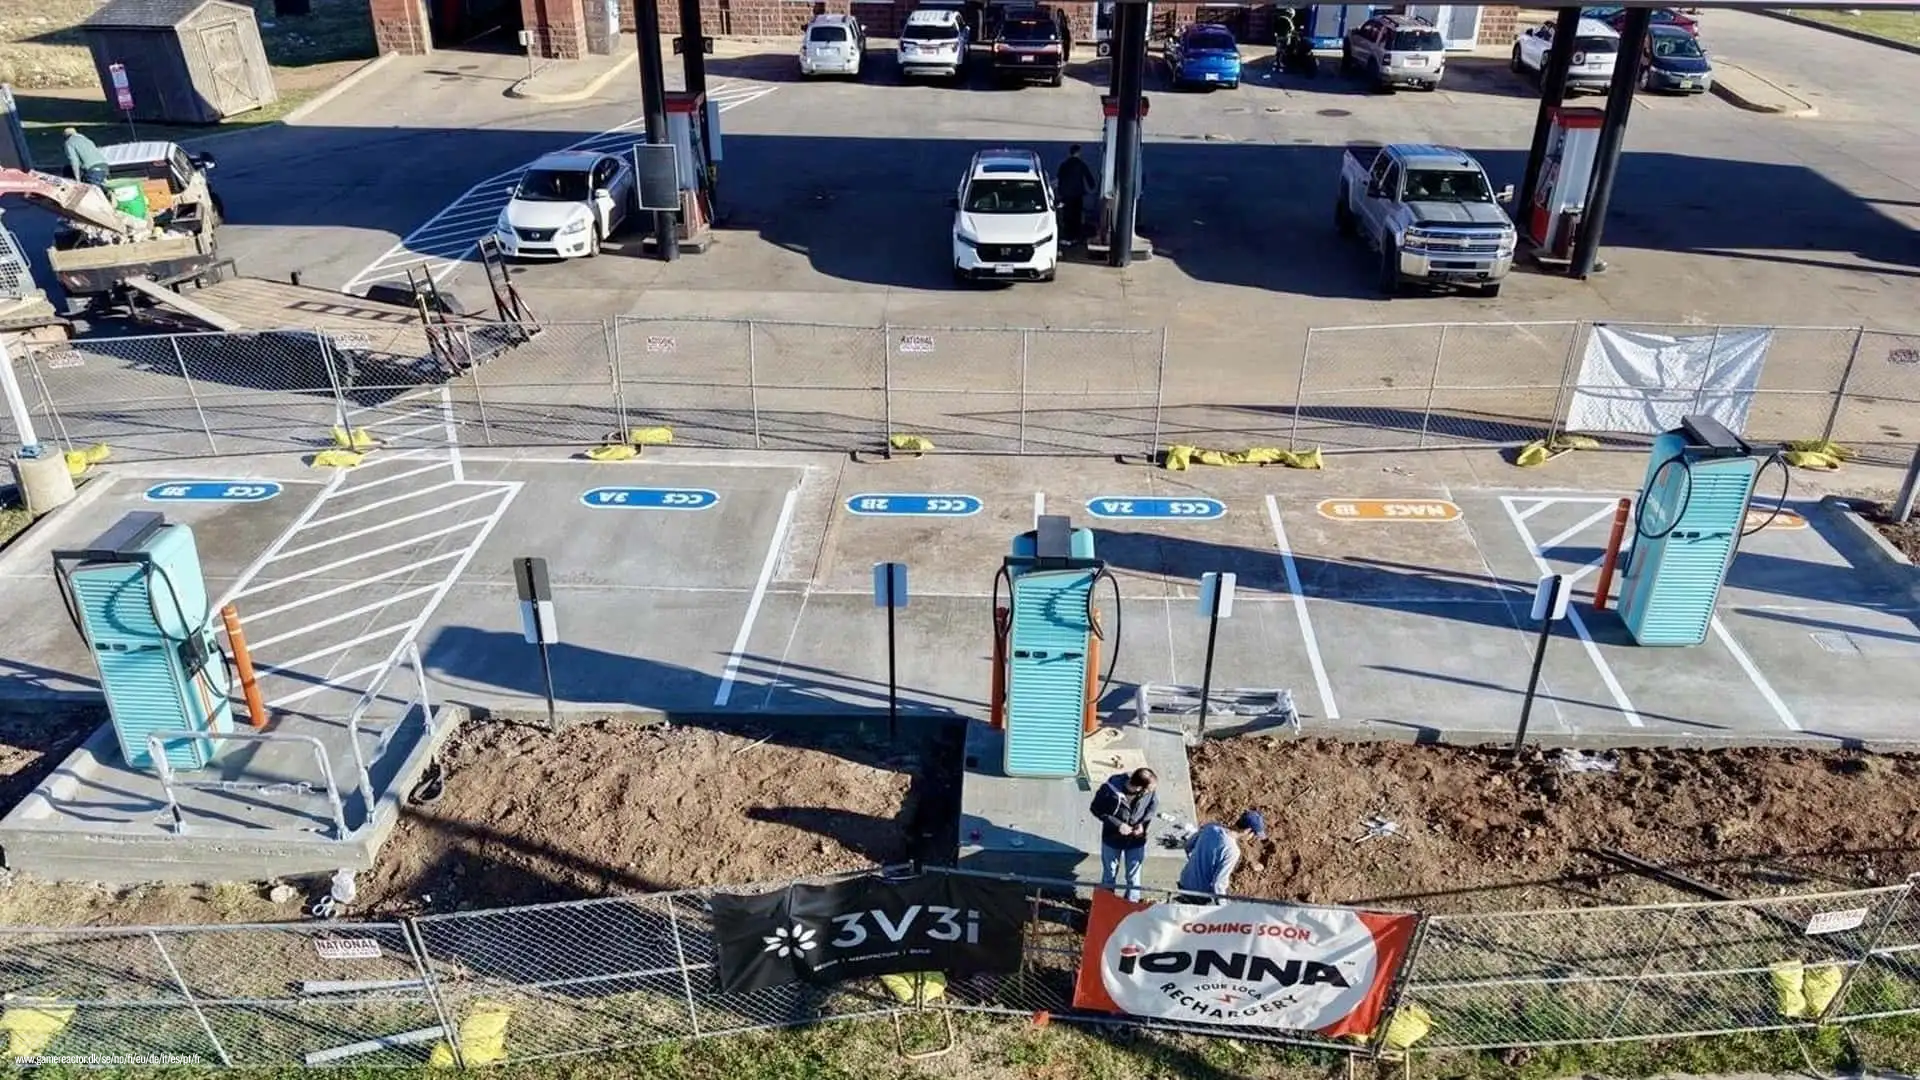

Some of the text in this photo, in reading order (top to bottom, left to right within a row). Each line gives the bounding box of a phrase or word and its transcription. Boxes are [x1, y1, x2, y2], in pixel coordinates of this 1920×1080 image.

[222, 486, 266, 497] CCS
[599, 492, 703, 504] CCS 3A
[861, 498, 967, 511] CCS 2B
[1101, 502, 1210, 514] CCS 2A
[1383, 504, 1446, 516] NACS
[1182, 922, 1310, 940] COMING SOON
[318, 940, 377, 949] NATIONAL
[1194, 983, 1228, 991] YOUR
[1160, 982, 1297, 1018] RECHARGERY
